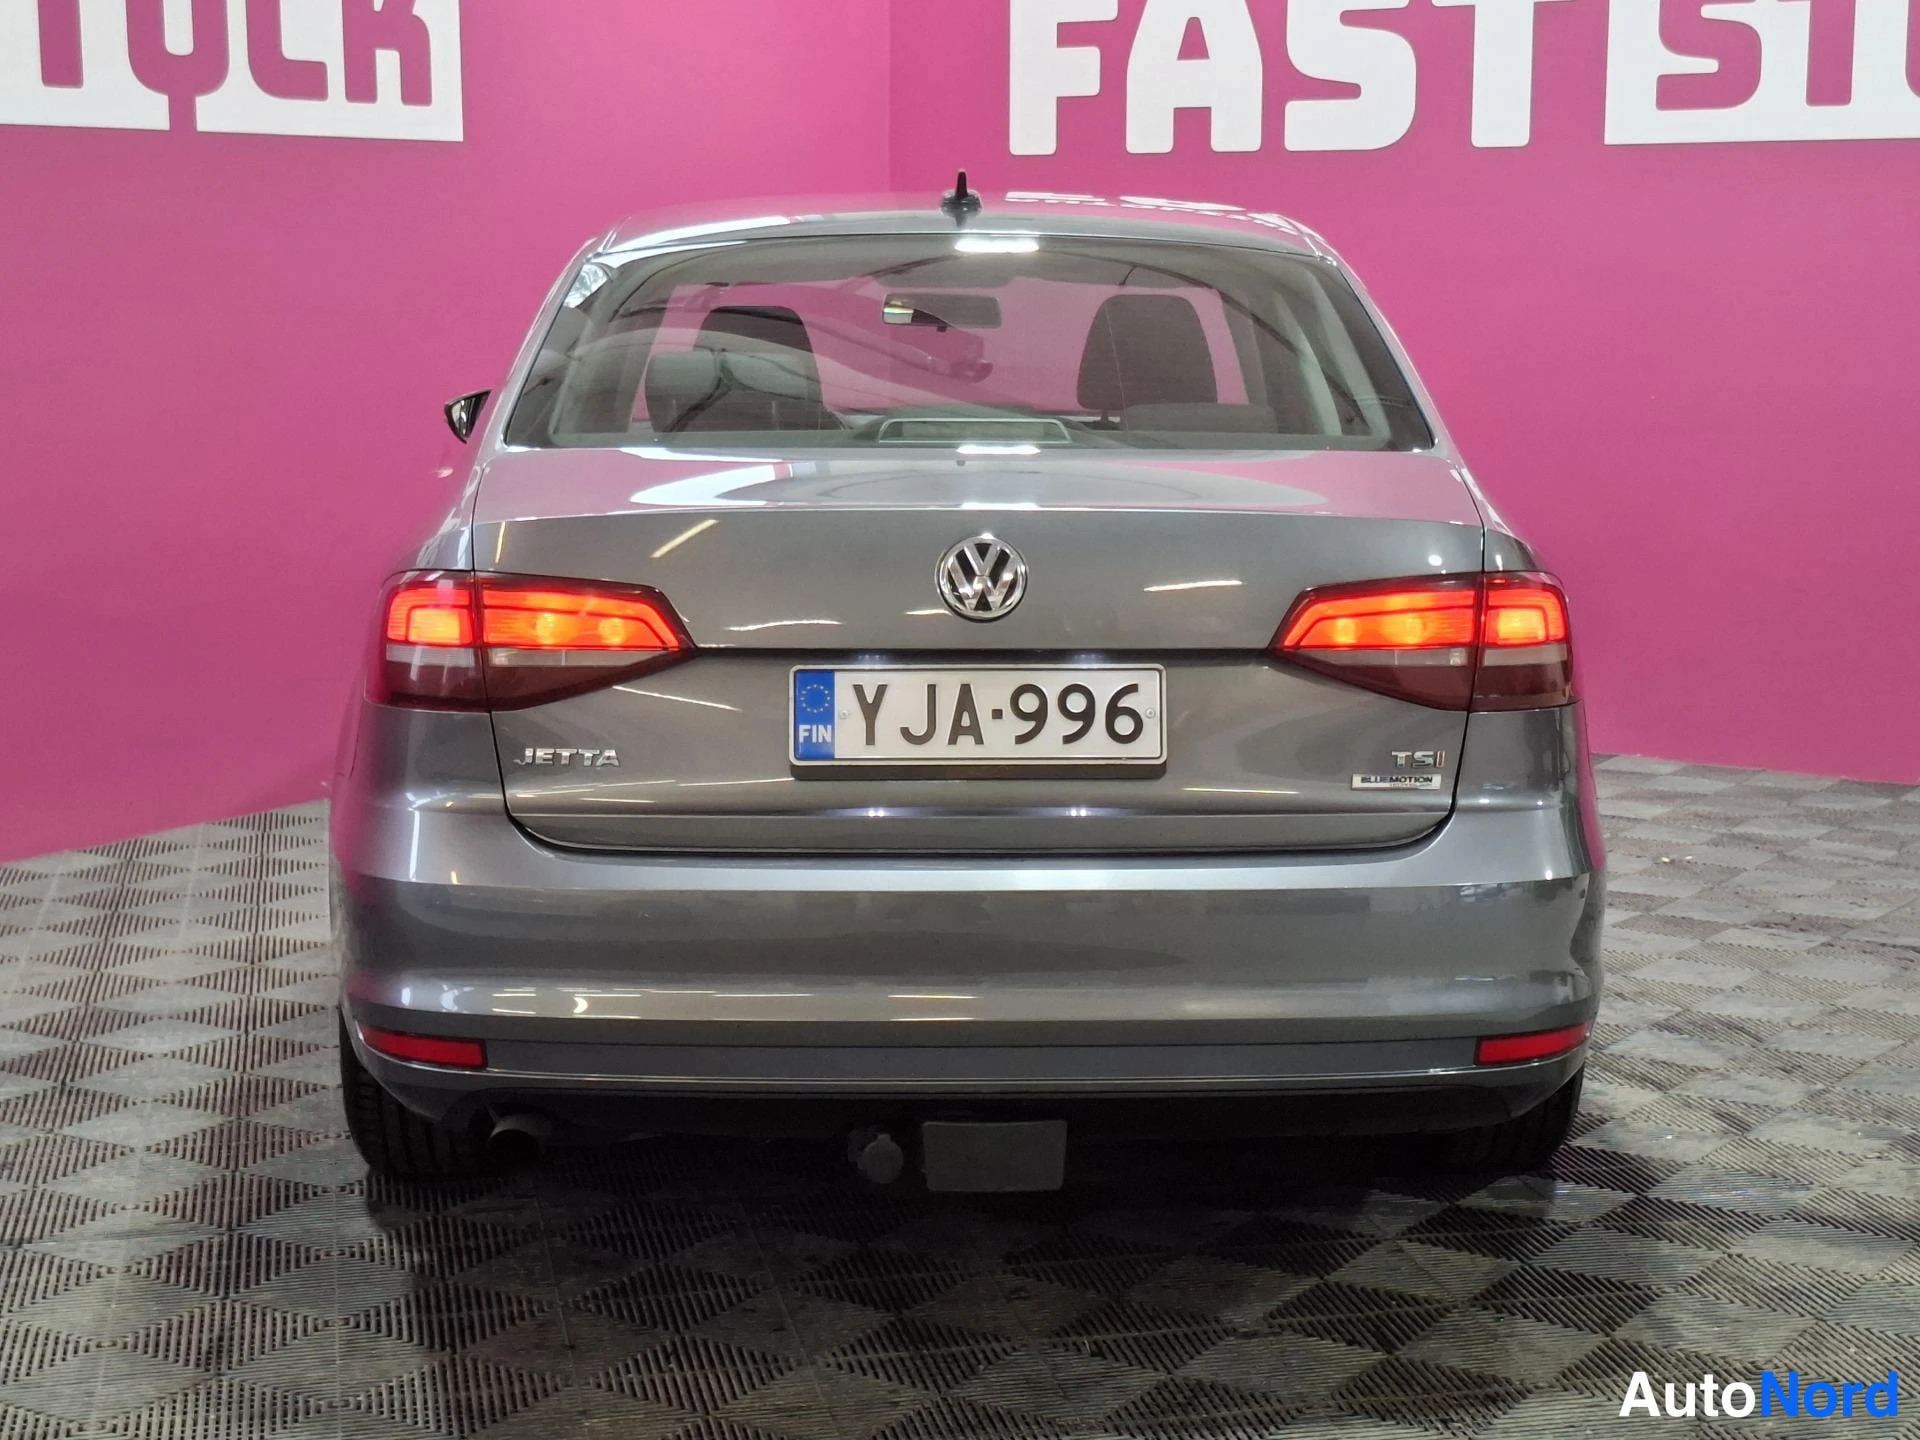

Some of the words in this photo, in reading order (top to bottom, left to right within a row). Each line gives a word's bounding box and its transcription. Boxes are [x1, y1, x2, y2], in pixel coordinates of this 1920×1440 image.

[1008, 0, 1573, 156] FAST
[852, 682, 1144, 746] YJA-996
[798, 724, 833, 744] FIN
[513, 747, 620, 767] JETTA
[1391, 750, 1446, 768] TSI
[1360, 775, 1433, 784] BLUEMOTION
